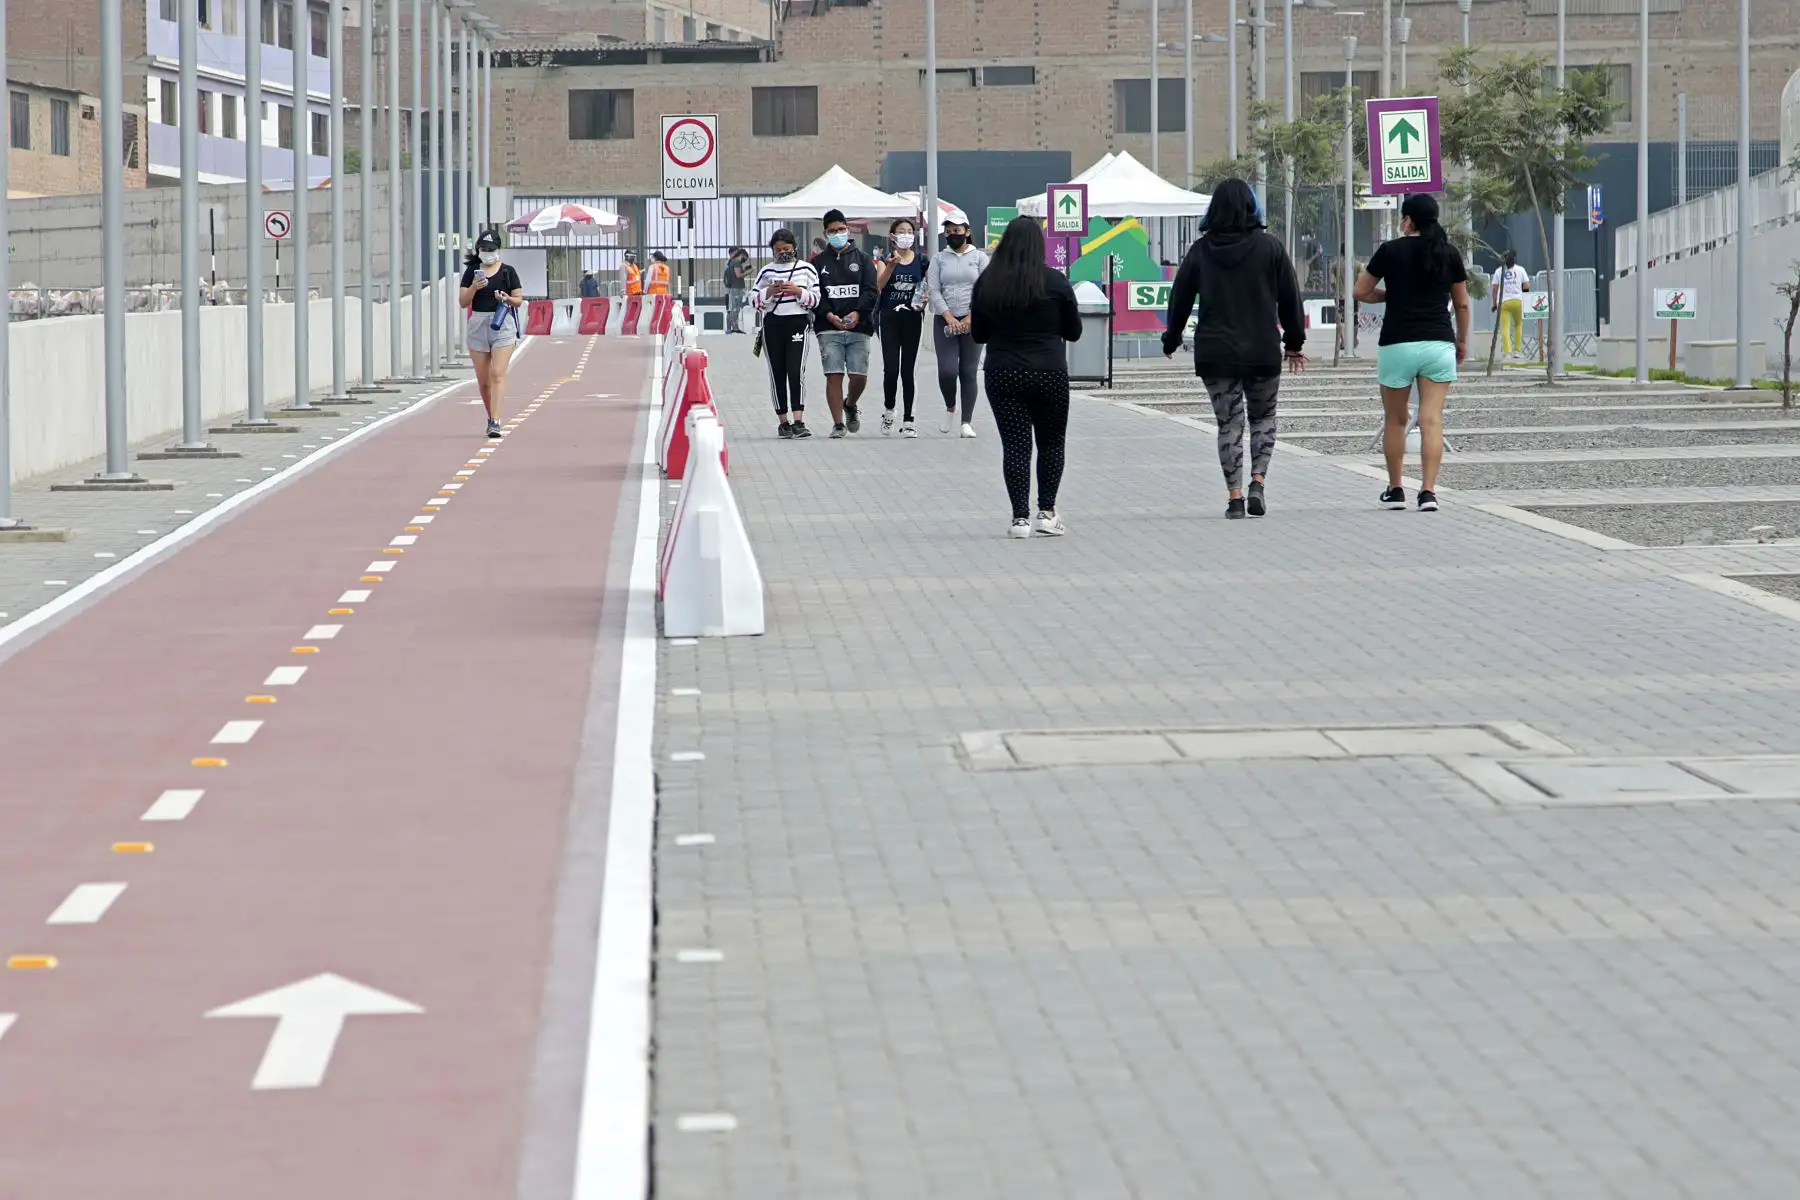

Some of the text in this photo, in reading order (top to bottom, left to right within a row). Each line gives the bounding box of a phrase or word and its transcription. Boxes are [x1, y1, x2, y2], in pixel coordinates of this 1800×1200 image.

[1387, 165, 1426, 179] SALIDA
[665, 177, 715, 189] CICLOVIA
[1057, 220, 1080, 229] SALIDA
[895, 274, 913, 282] FREE
